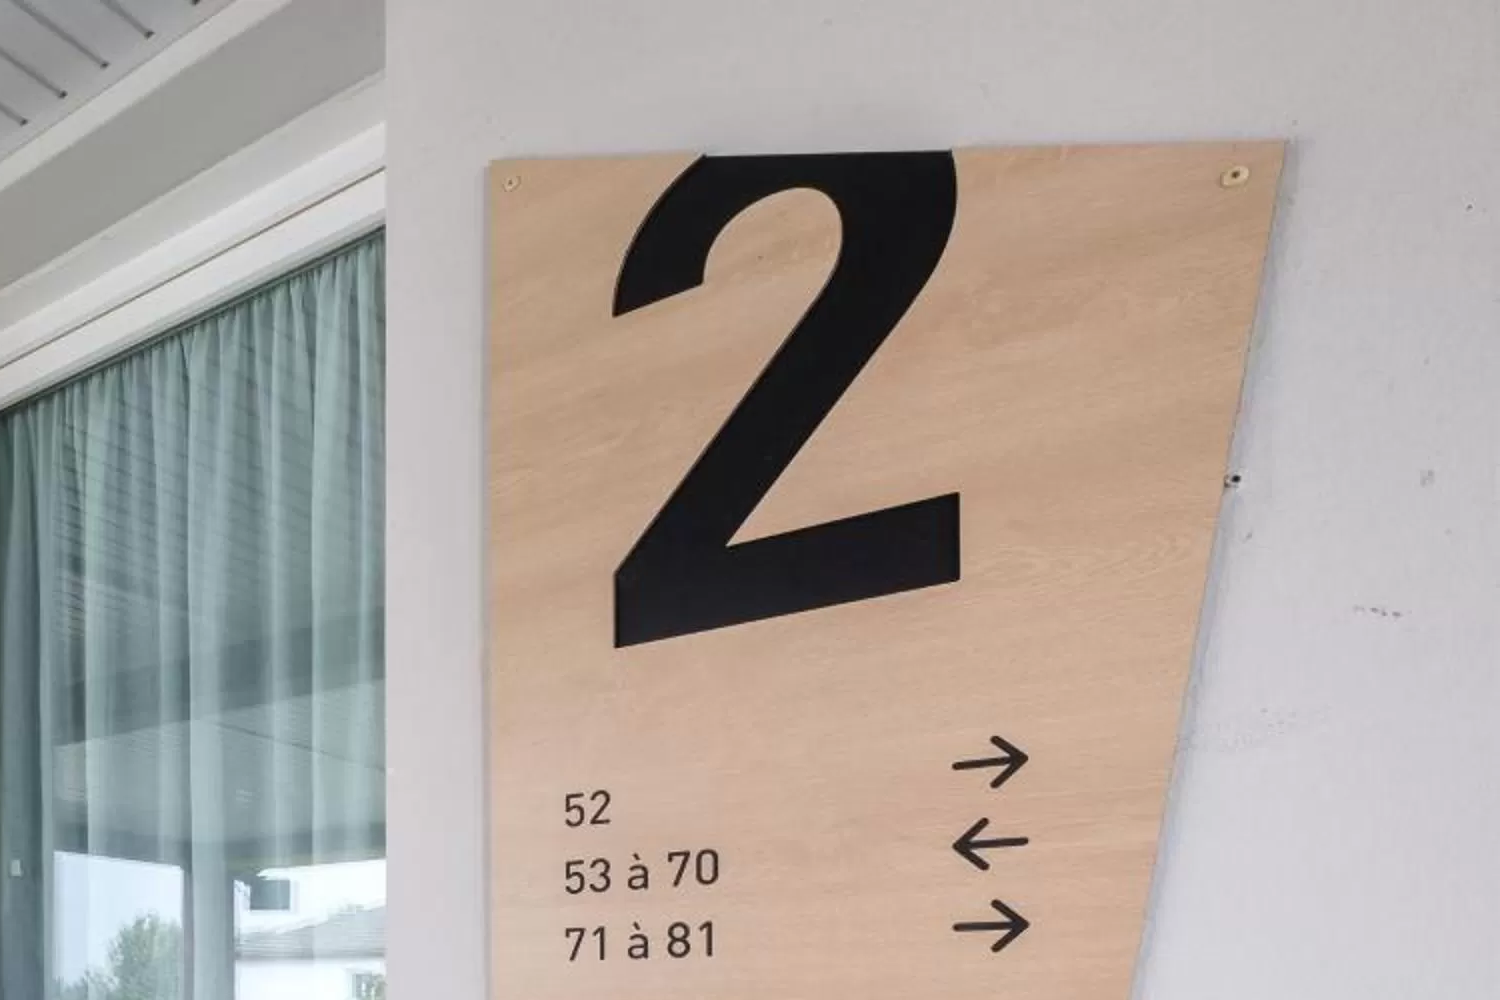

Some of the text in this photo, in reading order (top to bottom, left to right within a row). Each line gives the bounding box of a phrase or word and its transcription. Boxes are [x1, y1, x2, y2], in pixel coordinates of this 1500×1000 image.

[612, 150, 960, 648] 2
[564, 788, 612, 828] 52
[564, 847, 720, 896] 53 à 70
[564, 919, 714, 963] 71 à 81
